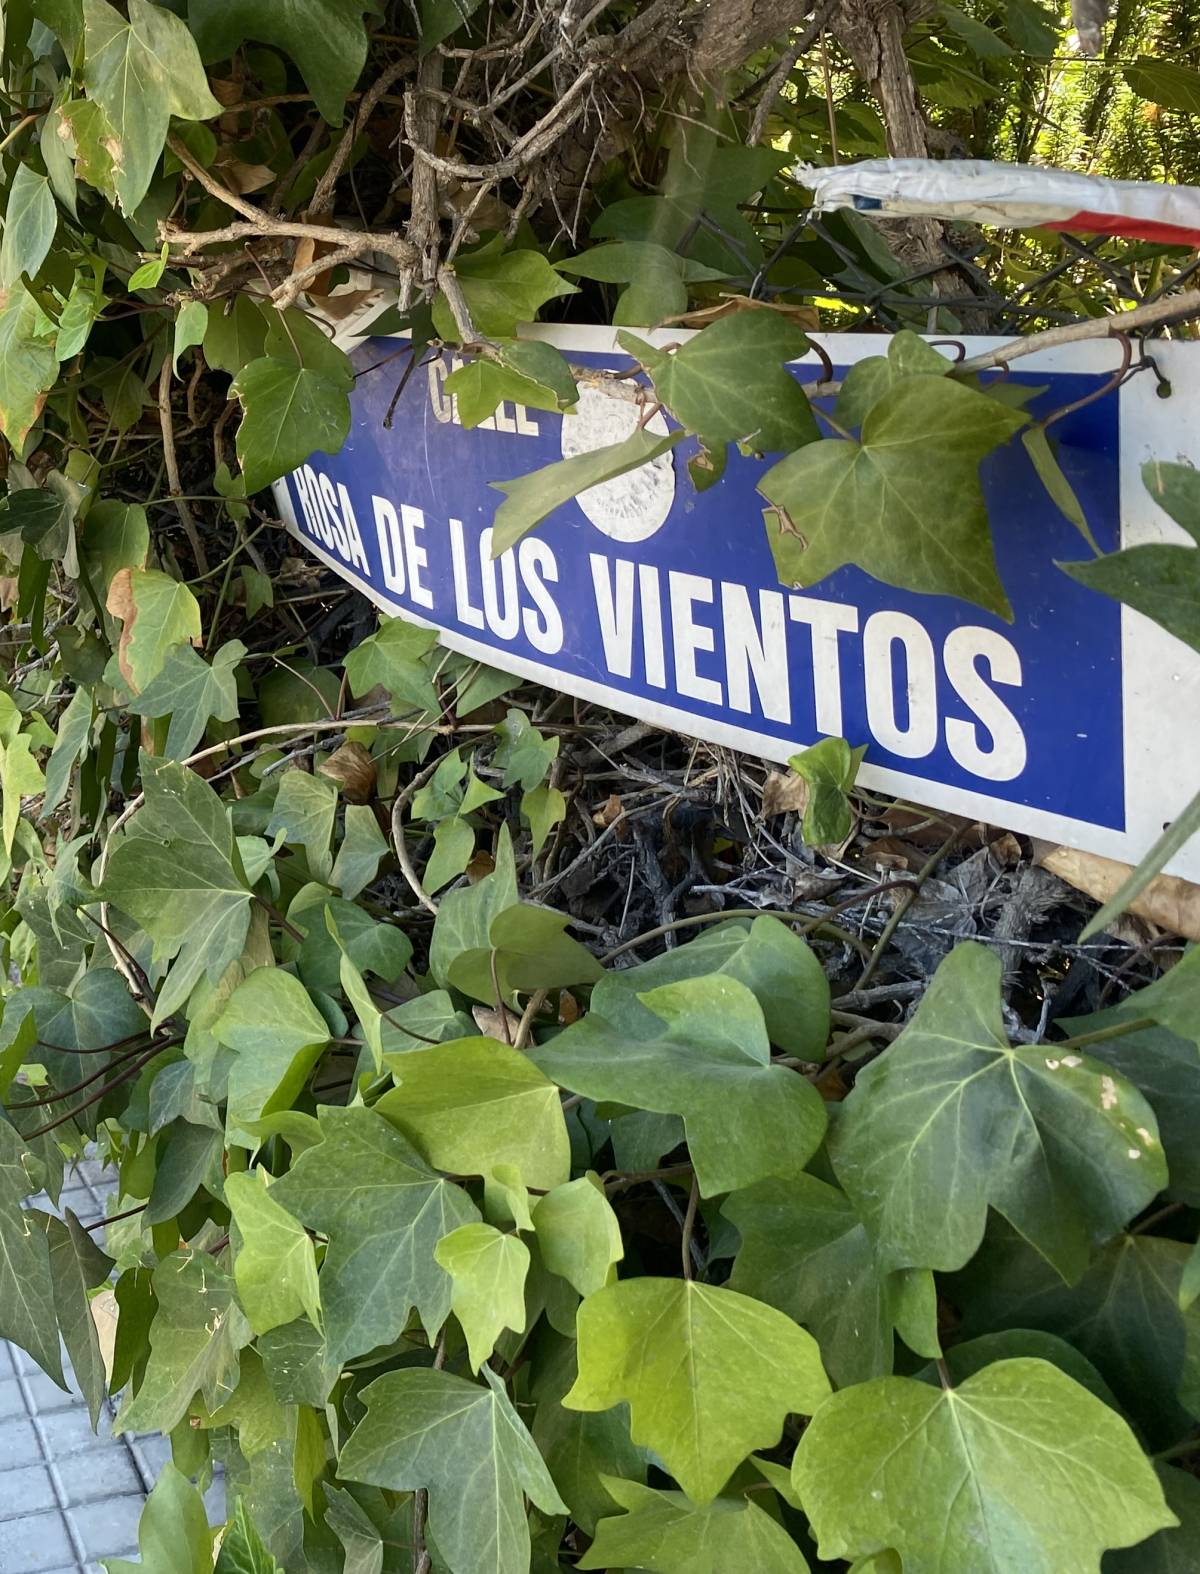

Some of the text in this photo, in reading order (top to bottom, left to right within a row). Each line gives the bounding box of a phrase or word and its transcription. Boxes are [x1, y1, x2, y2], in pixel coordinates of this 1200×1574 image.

[292, 463, 1028, 782] ROSA DE LOS VIENTOS
